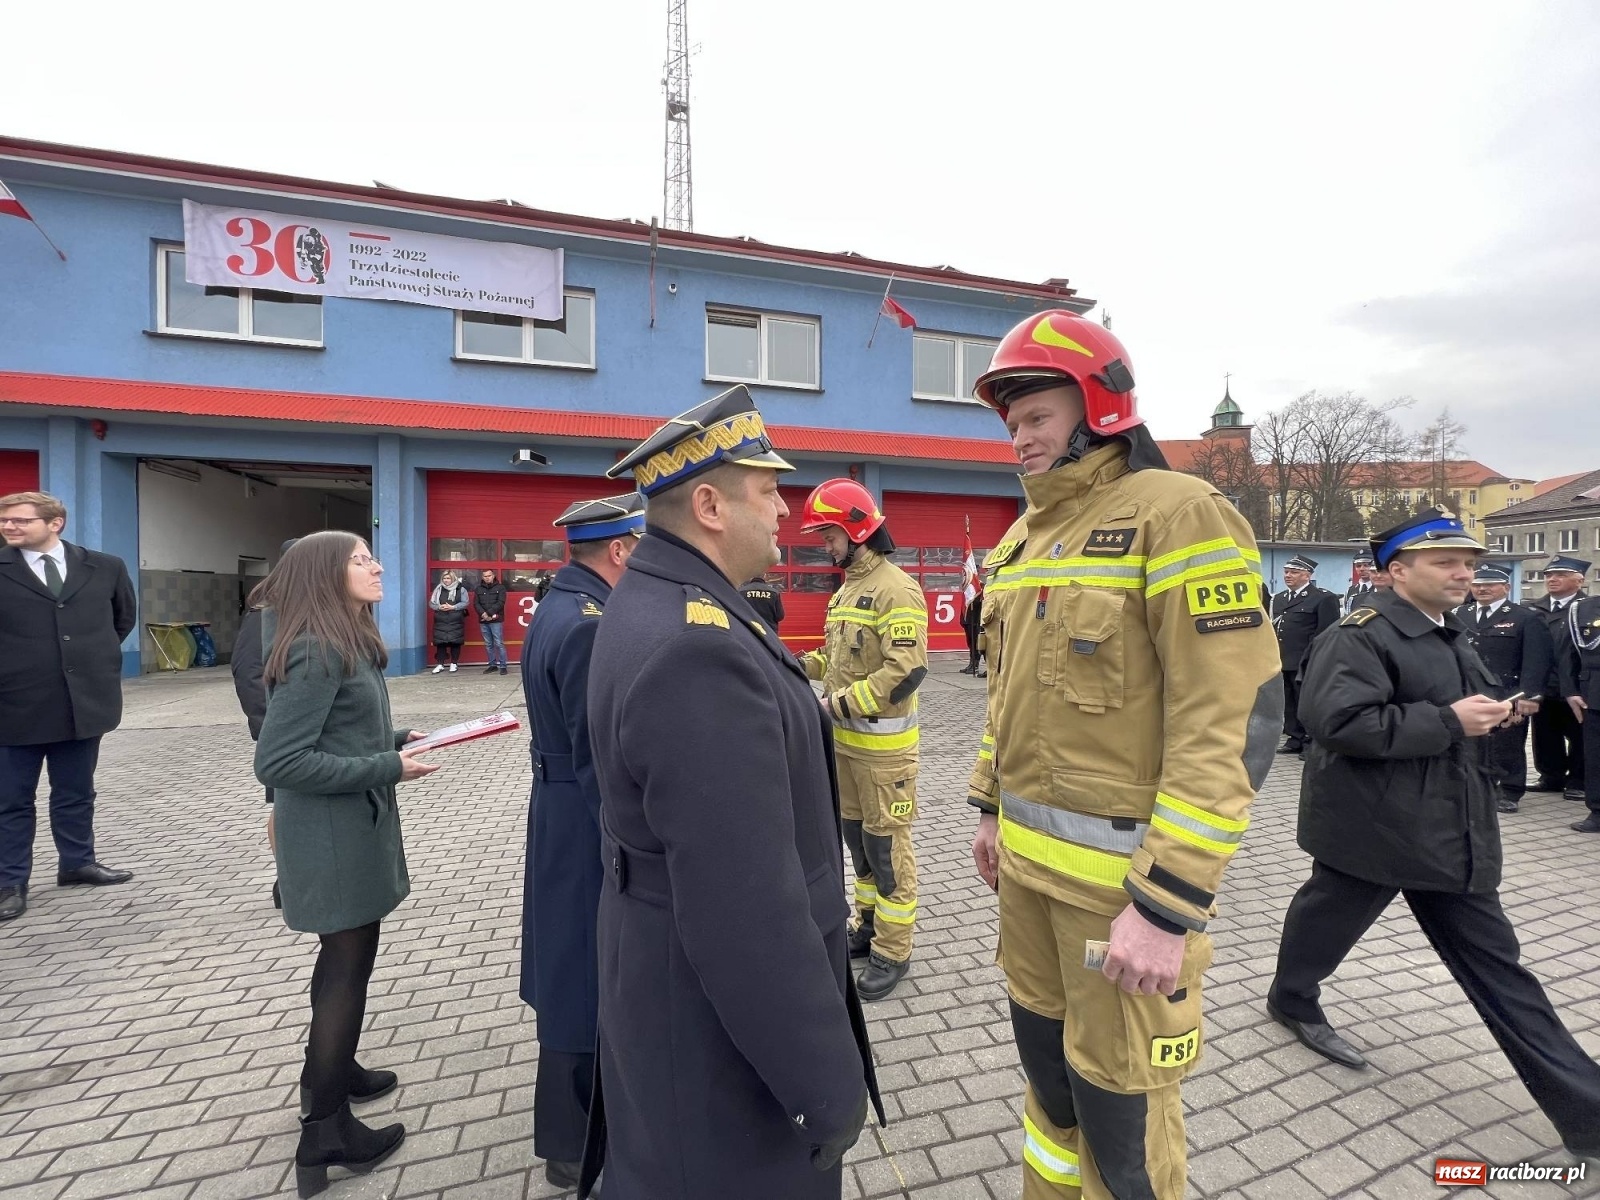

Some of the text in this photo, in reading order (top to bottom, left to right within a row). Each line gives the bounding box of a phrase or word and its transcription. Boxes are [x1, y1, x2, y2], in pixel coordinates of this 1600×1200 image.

[226, 217, 330, 284] 30
[349, 243, 382, 256] 1992
[392, 248, 427, 262] 2022
[349, 259, 460, 282] Trzydziestolecie
[349, 275, 535, 309] Państwowej Straży Pożarnej
[1196, 582, 1249, 608] PSP
[518, 596, 540, 627] 3
[934, 595, 955, 623] 5
[894, 626, 912, 635] PSP
[1206, 616, 1252, 628] RACIBÓRZ
[894, 803, 910, 814] PSP
[1160, 1038, 1194, 1062] PSP
